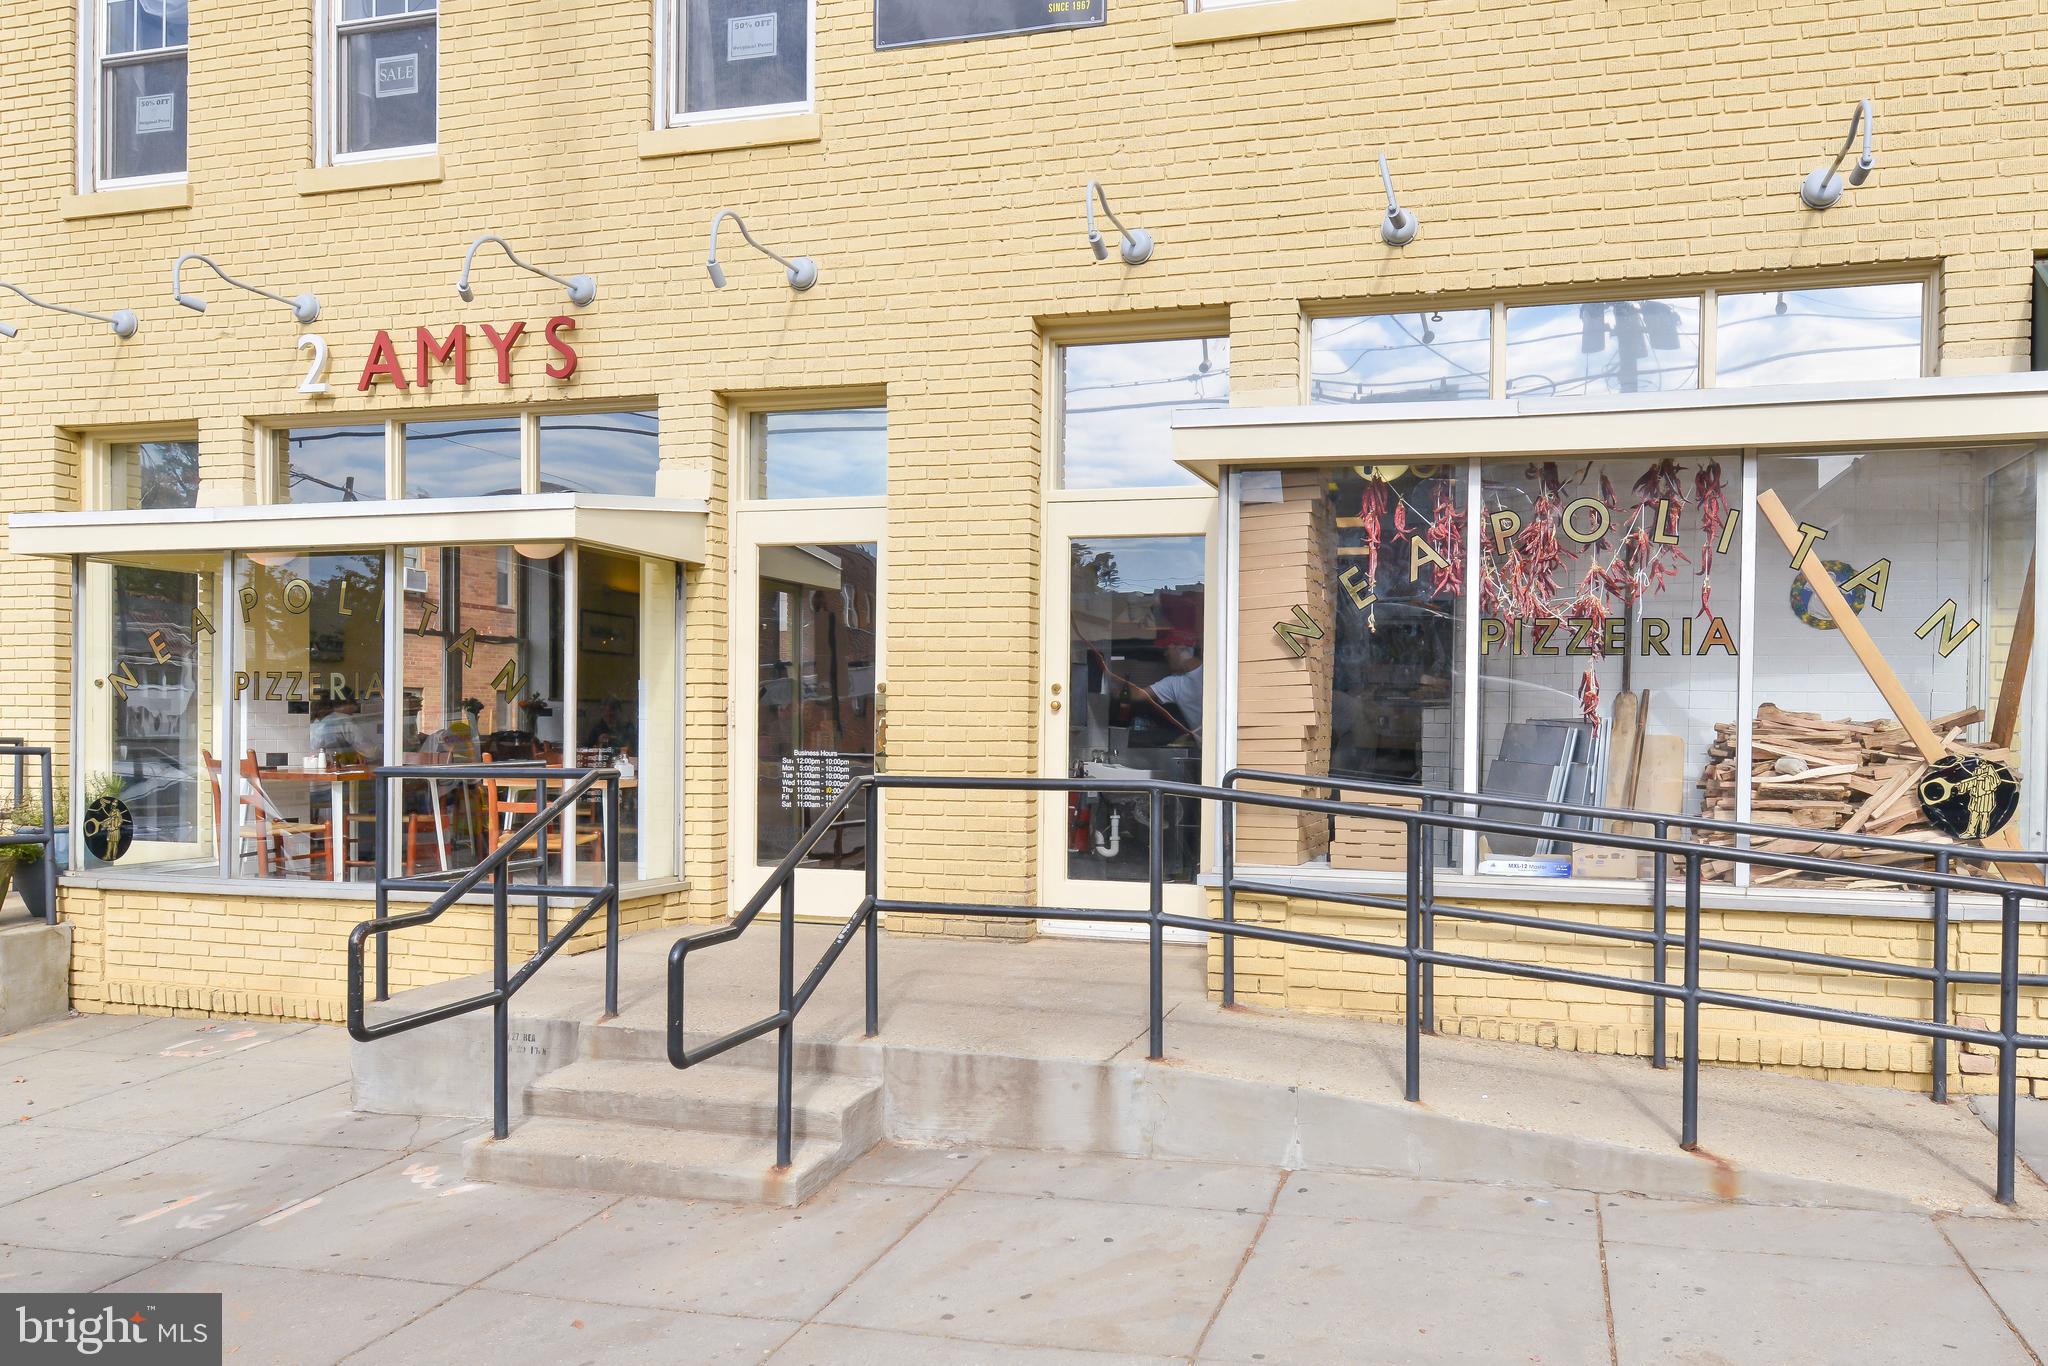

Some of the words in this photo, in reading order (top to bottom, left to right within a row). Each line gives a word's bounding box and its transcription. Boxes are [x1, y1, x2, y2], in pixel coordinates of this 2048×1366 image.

[1048, 1, 1070, 13] SINCE
[1072, 0, 1090, 10] 1967
[734, 21, 753, 30] 50%
[754, 19, 772, 28] OFF
[380, 65, 414, 82] SALE
[298, 333, 328, 392] 2
[357, 315, 578, 391] AMYS
[1273, 497, 1981, 659] NEAPOLITAN
[108, 578, 529, 704] NEAPOLITAN
[1481, 617, 1739, 656] PIZZERIA
[234, 671, 385, 701] PIZZERIA
[796, 757, 820, 765] 12:00pm
[825, 758, 850, 766] 10:00pm
[825, 765, 850, 773] 10:00pm
[825, 773, 850, 781] 10:00pm
